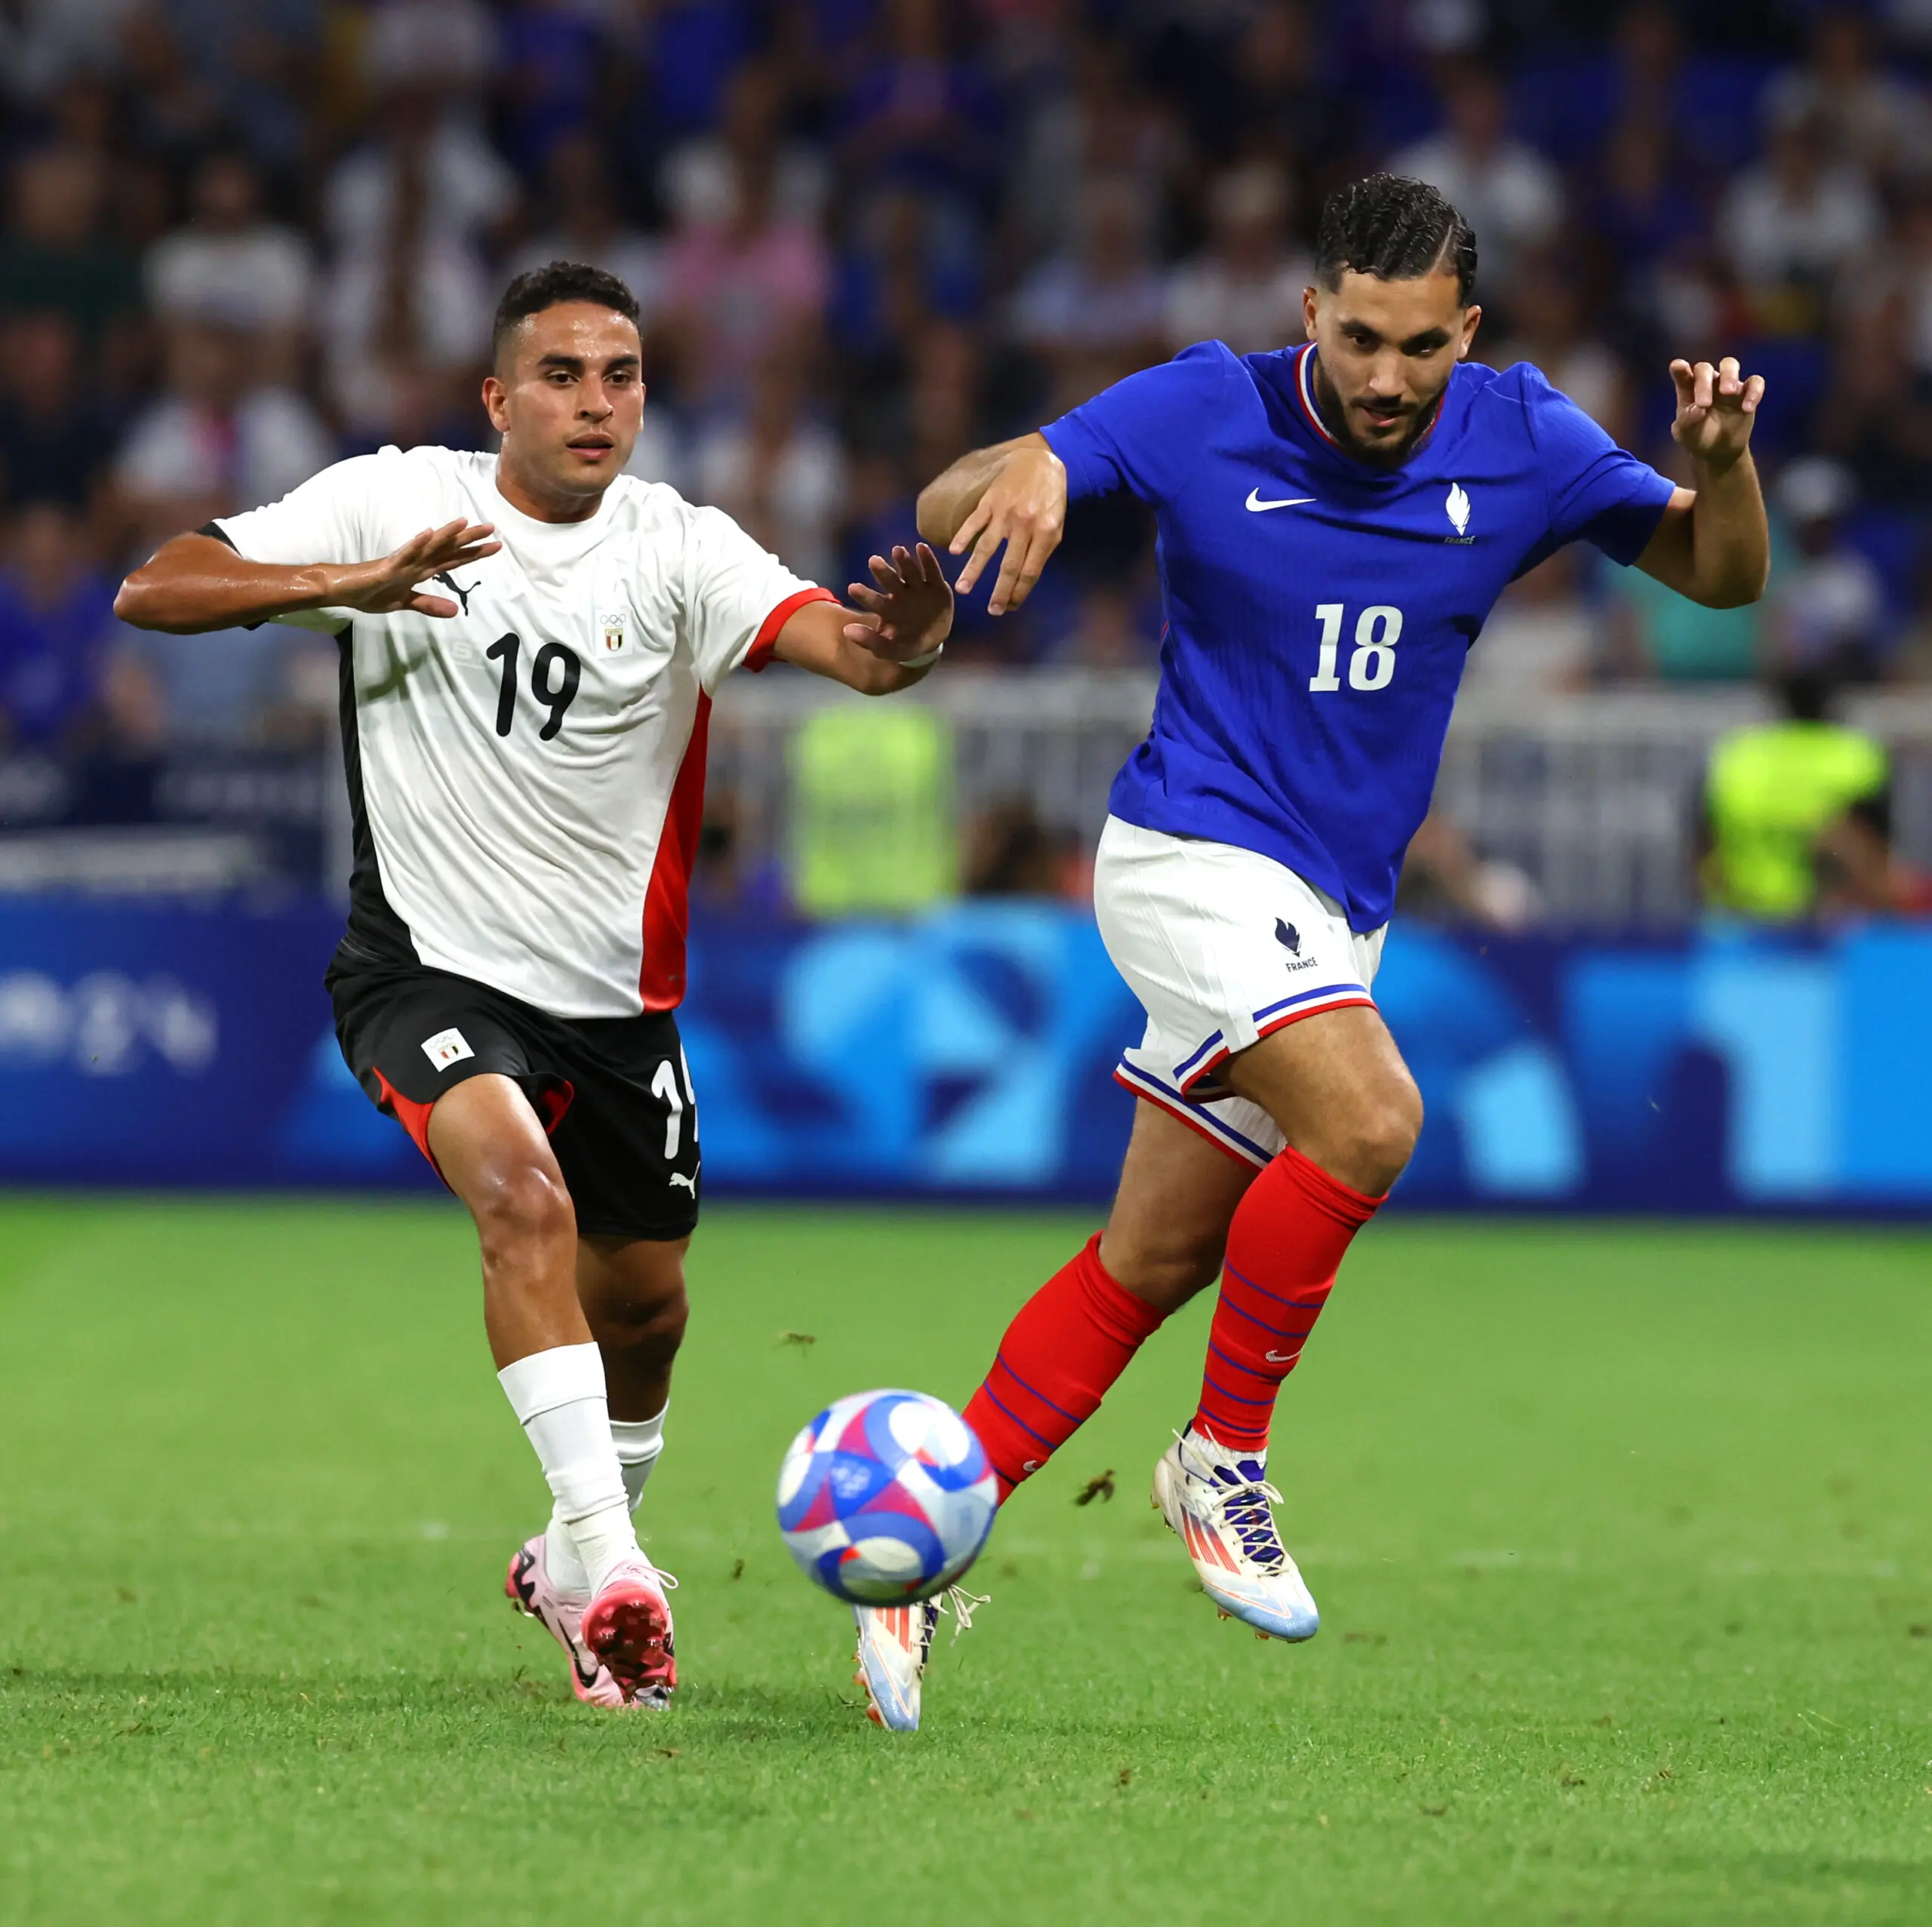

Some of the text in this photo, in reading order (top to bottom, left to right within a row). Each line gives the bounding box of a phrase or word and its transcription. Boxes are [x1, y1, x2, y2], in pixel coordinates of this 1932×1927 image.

[1444, 535, 1476, 545] FRANCE
[1309, 603, 1404, 692] 18
[486, 632, 581, 741] 19
[1285, 956, 1318, 973] FRANCE
